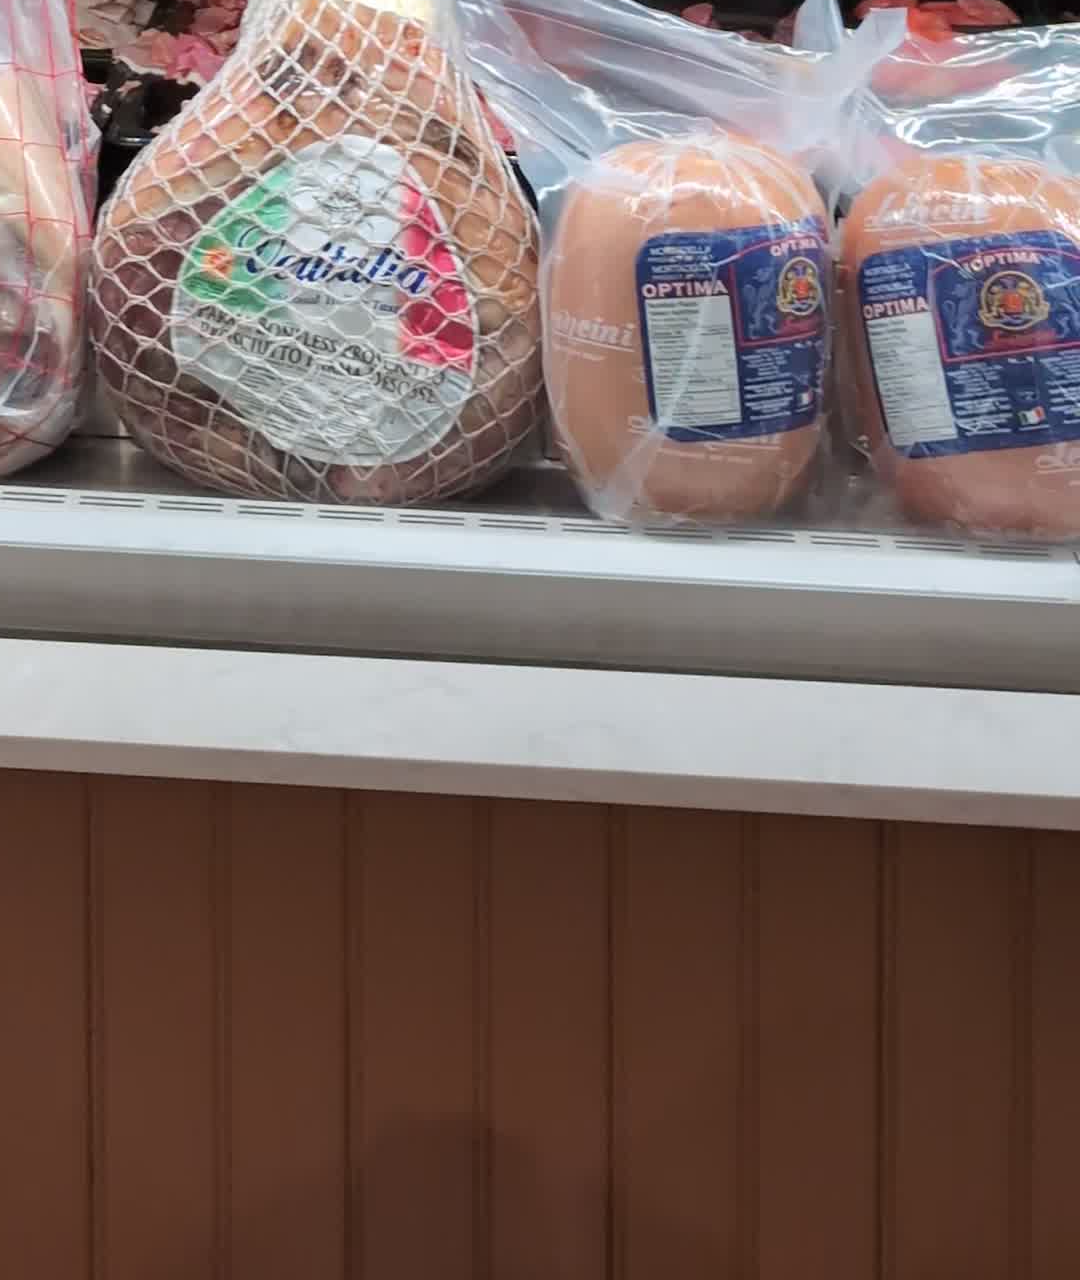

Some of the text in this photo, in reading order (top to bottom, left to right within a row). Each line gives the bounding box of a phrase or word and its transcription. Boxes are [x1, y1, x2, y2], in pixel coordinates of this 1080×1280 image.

[970, 252, 1041, 272] OPTIMA
[642, 280, 728, 298] OPTIMA
[863, 296, 928, 319] OPTIMA
